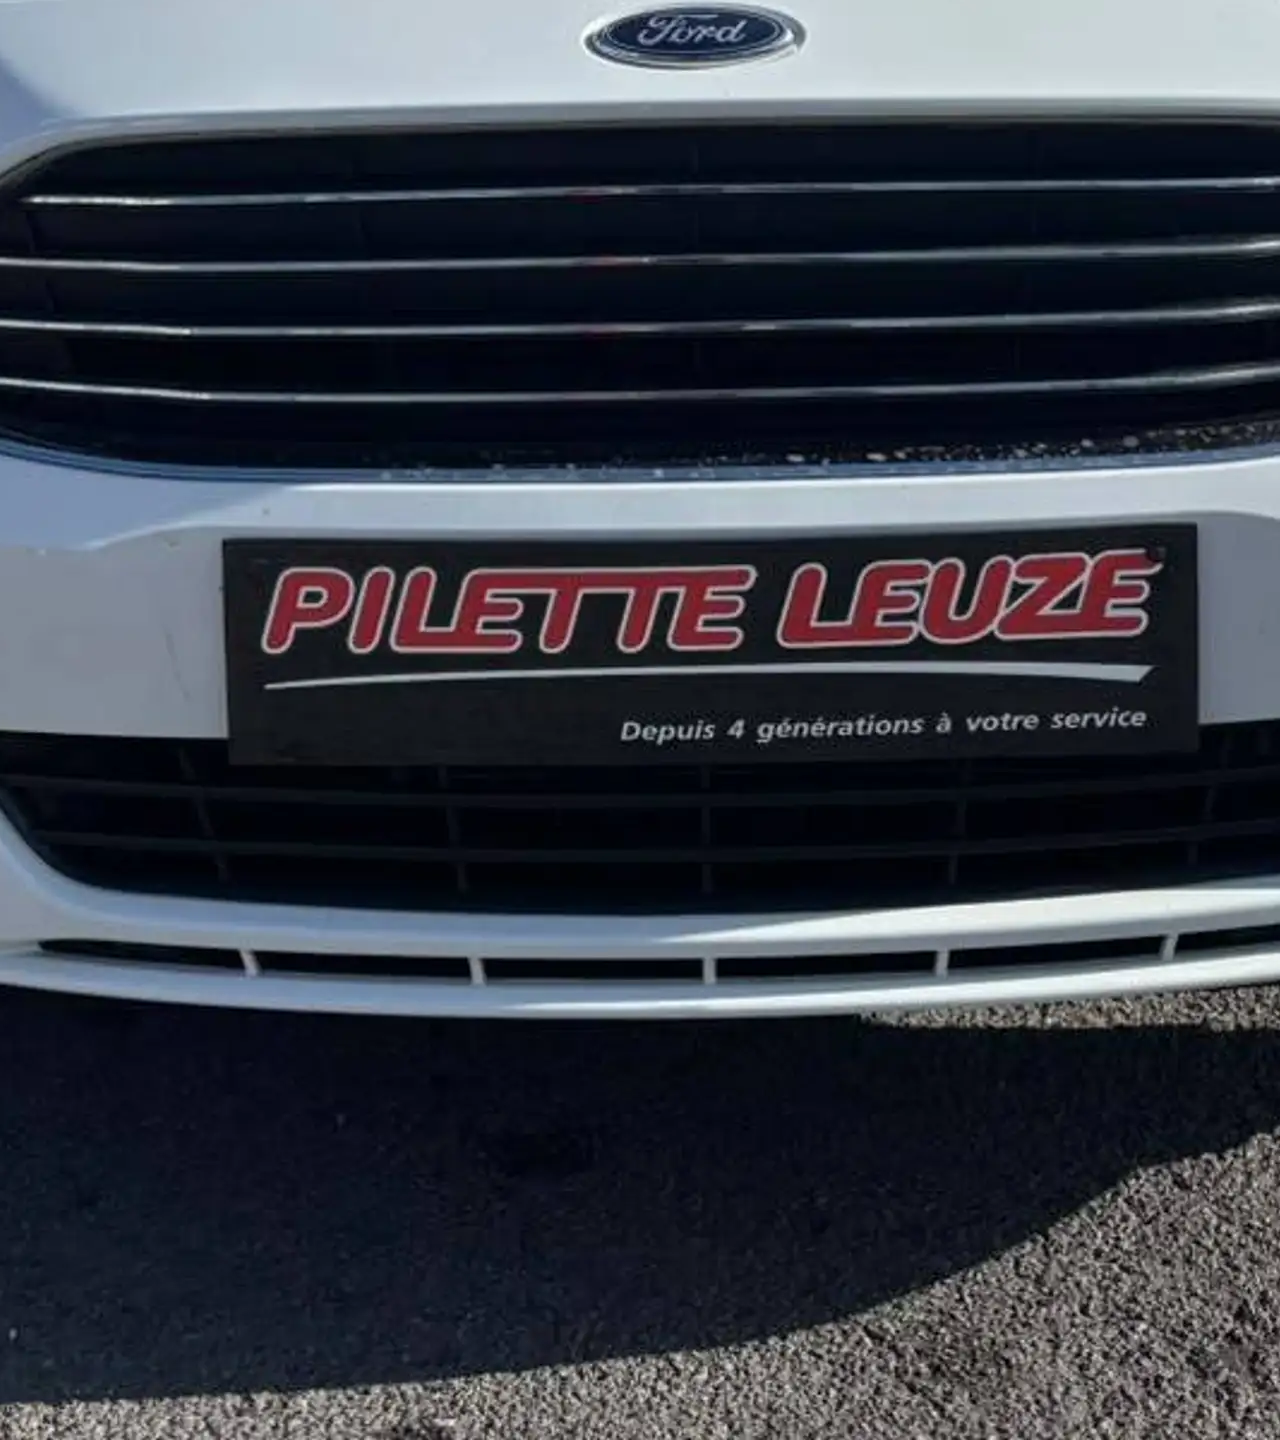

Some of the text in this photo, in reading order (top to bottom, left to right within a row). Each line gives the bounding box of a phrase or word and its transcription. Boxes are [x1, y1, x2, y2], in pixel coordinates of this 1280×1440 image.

[637, 14, 748, 46] Ford
[261, 548, 1164, 654] PILETTE LEUZE
[620, 706, 1147, 746] Depuis 4 générations à votre service
